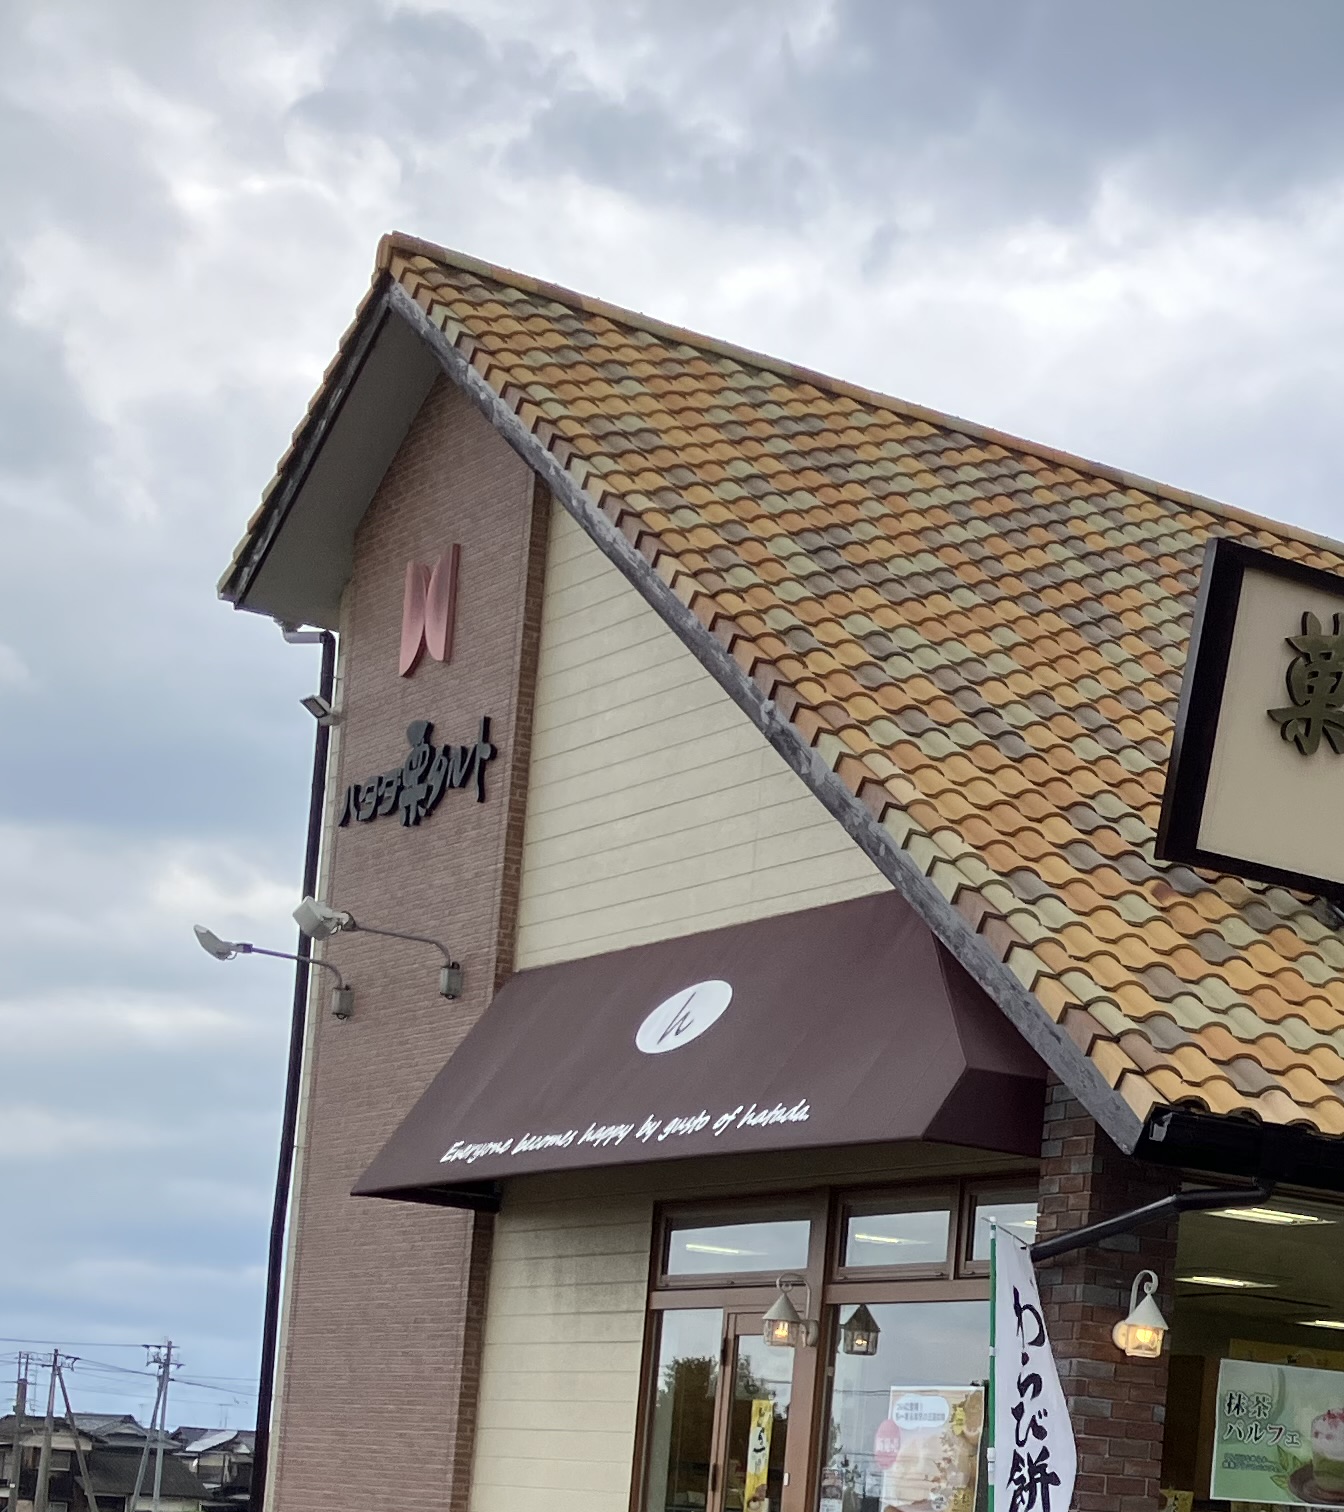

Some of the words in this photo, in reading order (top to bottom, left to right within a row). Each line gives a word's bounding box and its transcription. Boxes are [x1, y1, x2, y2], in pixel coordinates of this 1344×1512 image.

[338, 716, 498, 828] ハタダ栗タルト
[656, 990, 696, 1045] h
[440, 1137, 512, 1165] Everyone
[511, 1129, 577, 1156] becomes
[577, 1121, 636, 1147] happy
[635, 1113, 658, 1143] by
[657, 1109, 712, 1141] gusto
[713, 1105, 744, 1137] of
[1226, 1391, 1272, 1419] 抹茶
[1223, 1421, 1300, 1446] パルフェ
